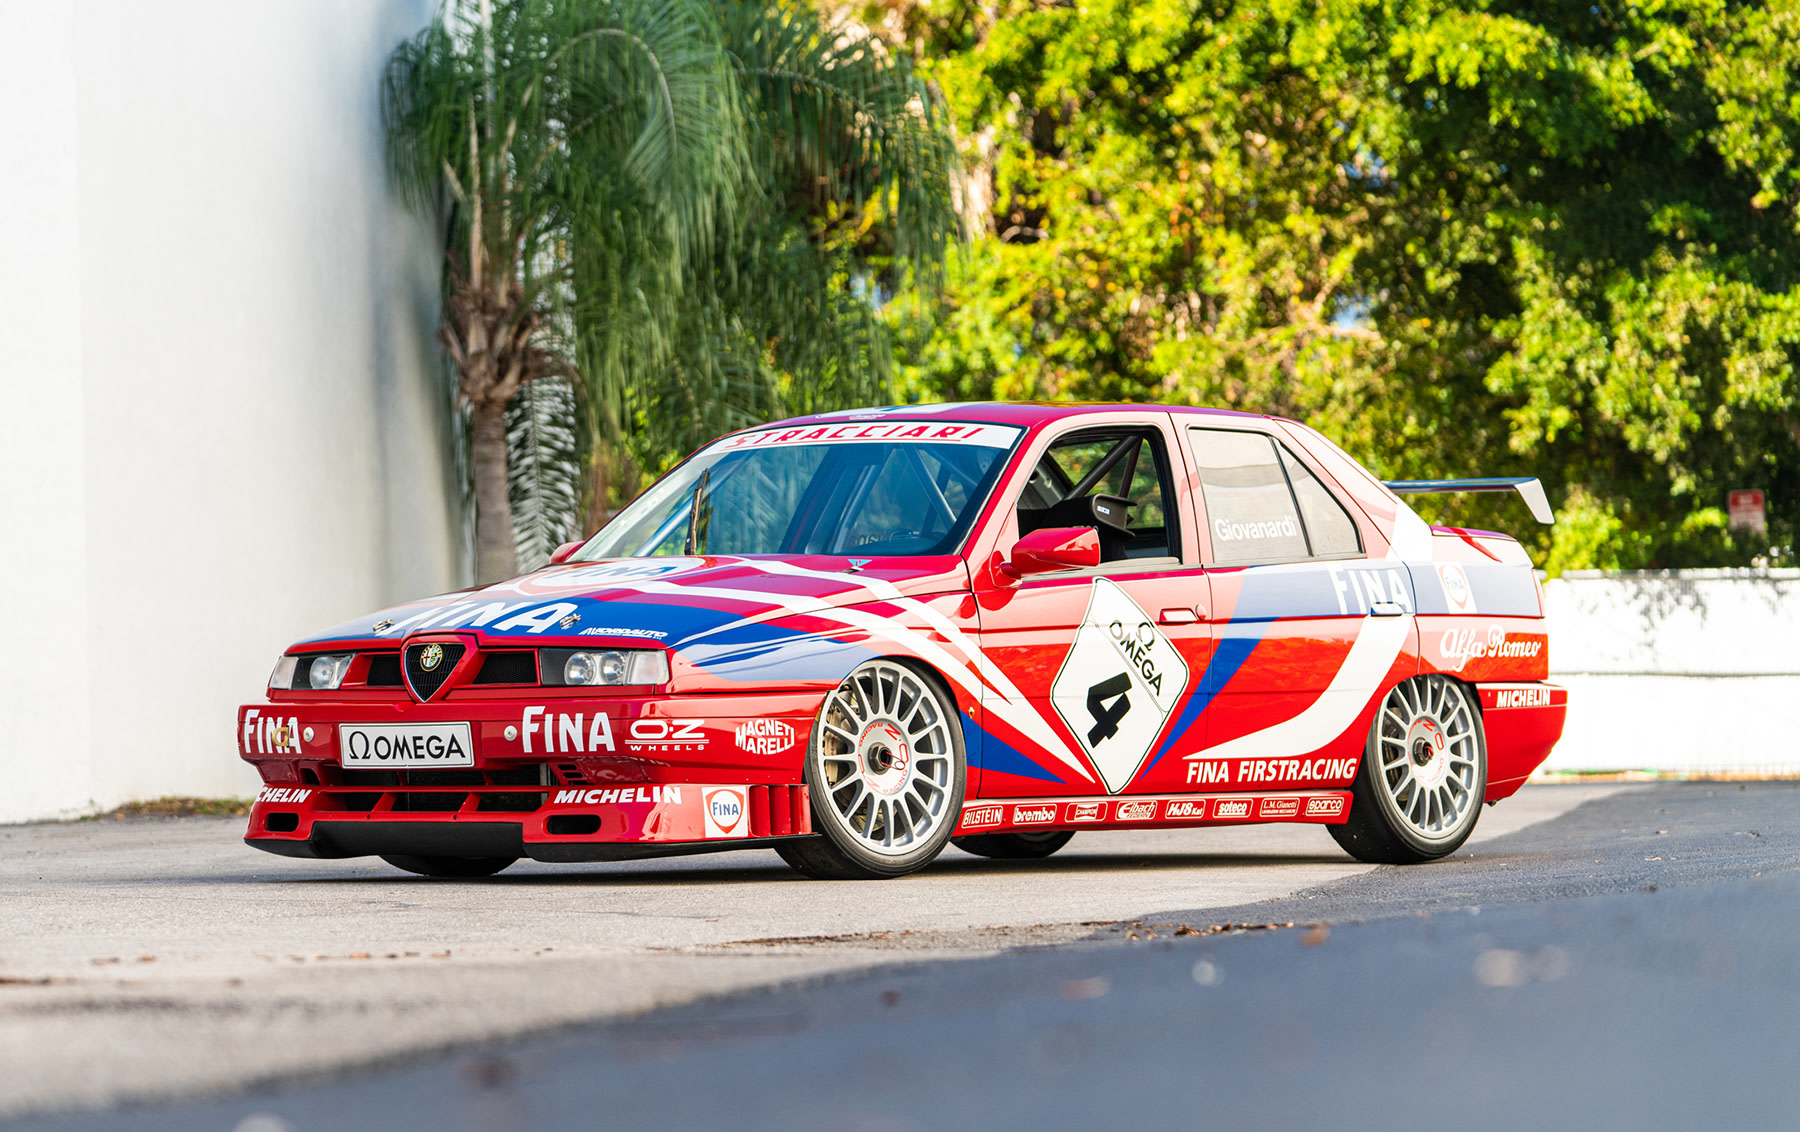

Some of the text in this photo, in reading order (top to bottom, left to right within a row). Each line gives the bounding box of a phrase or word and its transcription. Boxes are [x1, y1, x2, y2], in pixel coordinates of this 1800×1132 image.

[726, 425, 985, 448] STRACCIARI
[1215, 516, 1297, 542] Giovanardi
[1326, 563, 1414, 614] FINA
[1109, 619, 1163, 696] OMEGA
[1440, 624, 1541, 672] Alfa Romeo
[1086, 671, 1132, 749] 4
[1497, 689, 1550, 708] MICHELIN
[244, 709, 302, 754] FINA
[522, 706, 616, 753] FINA
[735, 718, 795, 745] MAGNETI
[374, 733, 466, 759] OMEGA
[735, 731, 795, 755] MARELLI
[1187, 758, 1357, 783] FINA FIRSTRACING
[554, 786, 682, 805] MICHELIN
[1219, 801, 1247, 813] soteco
[1309, 800, 1342, 812] sparco
[712, 801, 739, 816] FINA
[963, 809, 1002, 826] BILSTEIN
[1015, 806, 1055, 823] brembo
